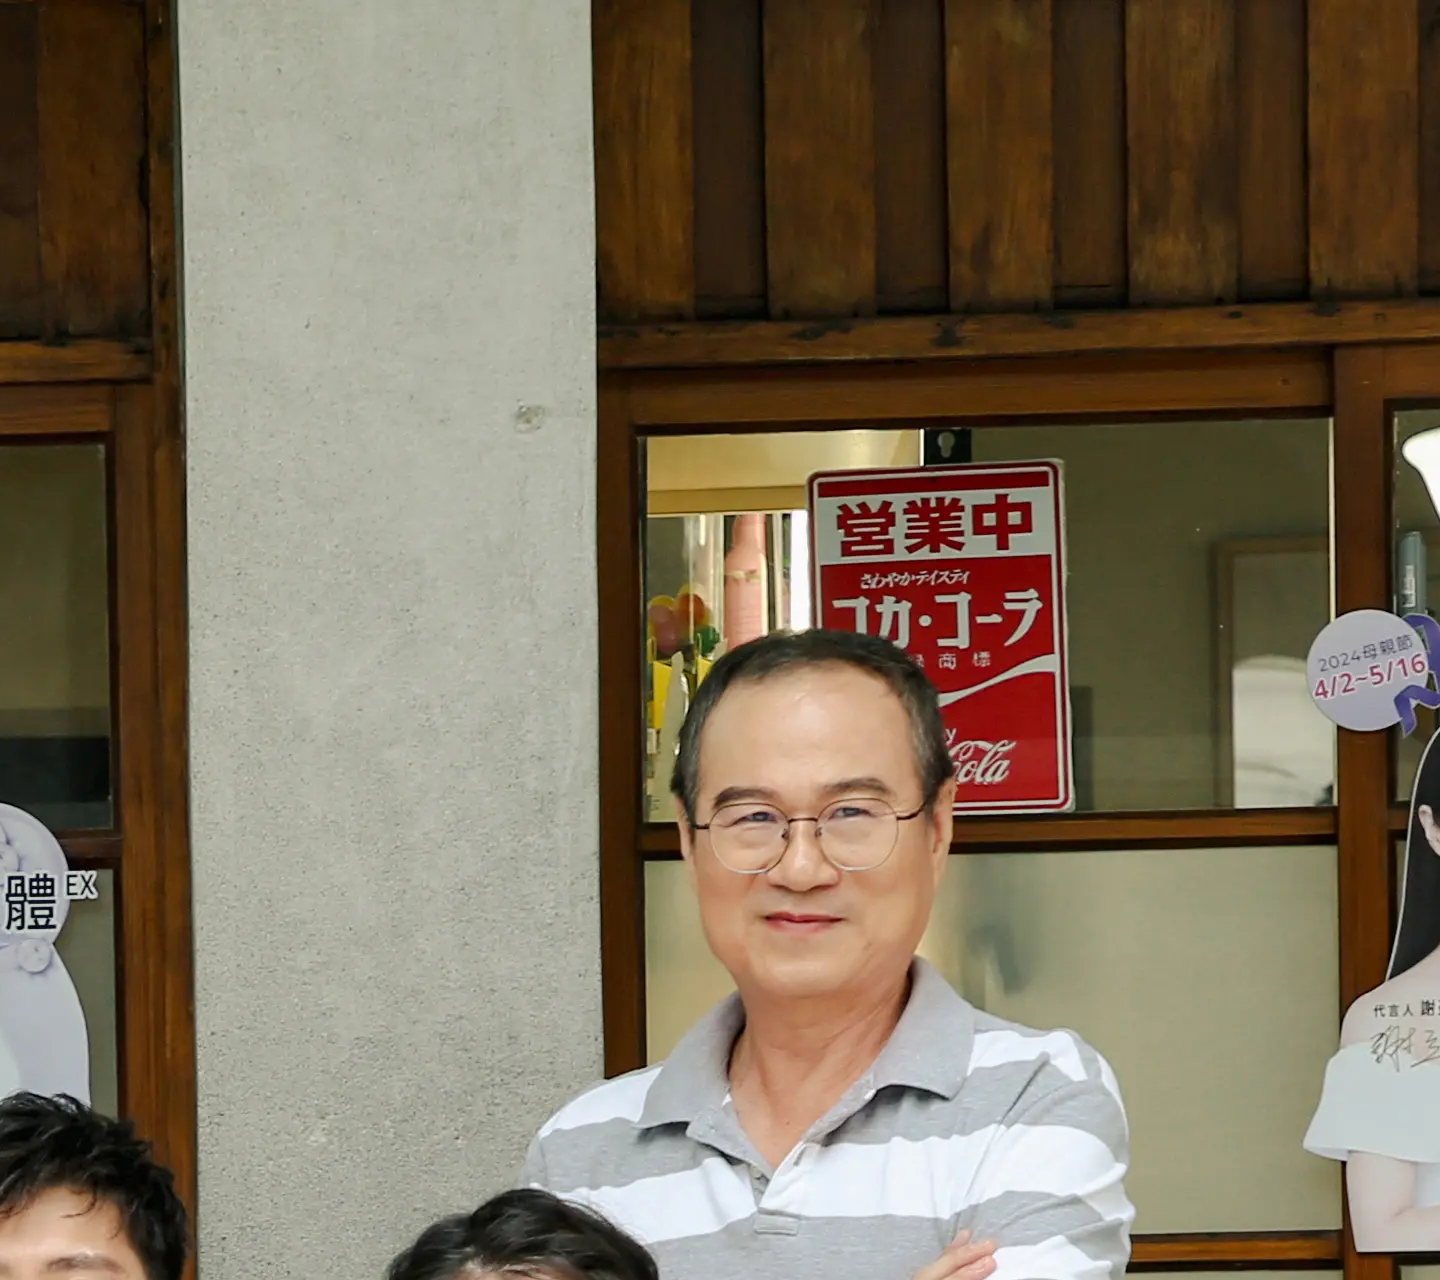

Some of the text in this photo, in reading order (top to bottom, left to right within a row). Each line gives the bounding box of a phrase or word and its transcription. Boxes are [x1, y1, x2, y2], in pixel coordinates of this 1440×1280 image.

[836, 494, 1033, 558] 営業中
[1318, 634, 1414, 674] 2024母親節
[1314, 653, 1427, 701] 4/2~5/16
[1373, 1004, 1414, 1017] 代言人
